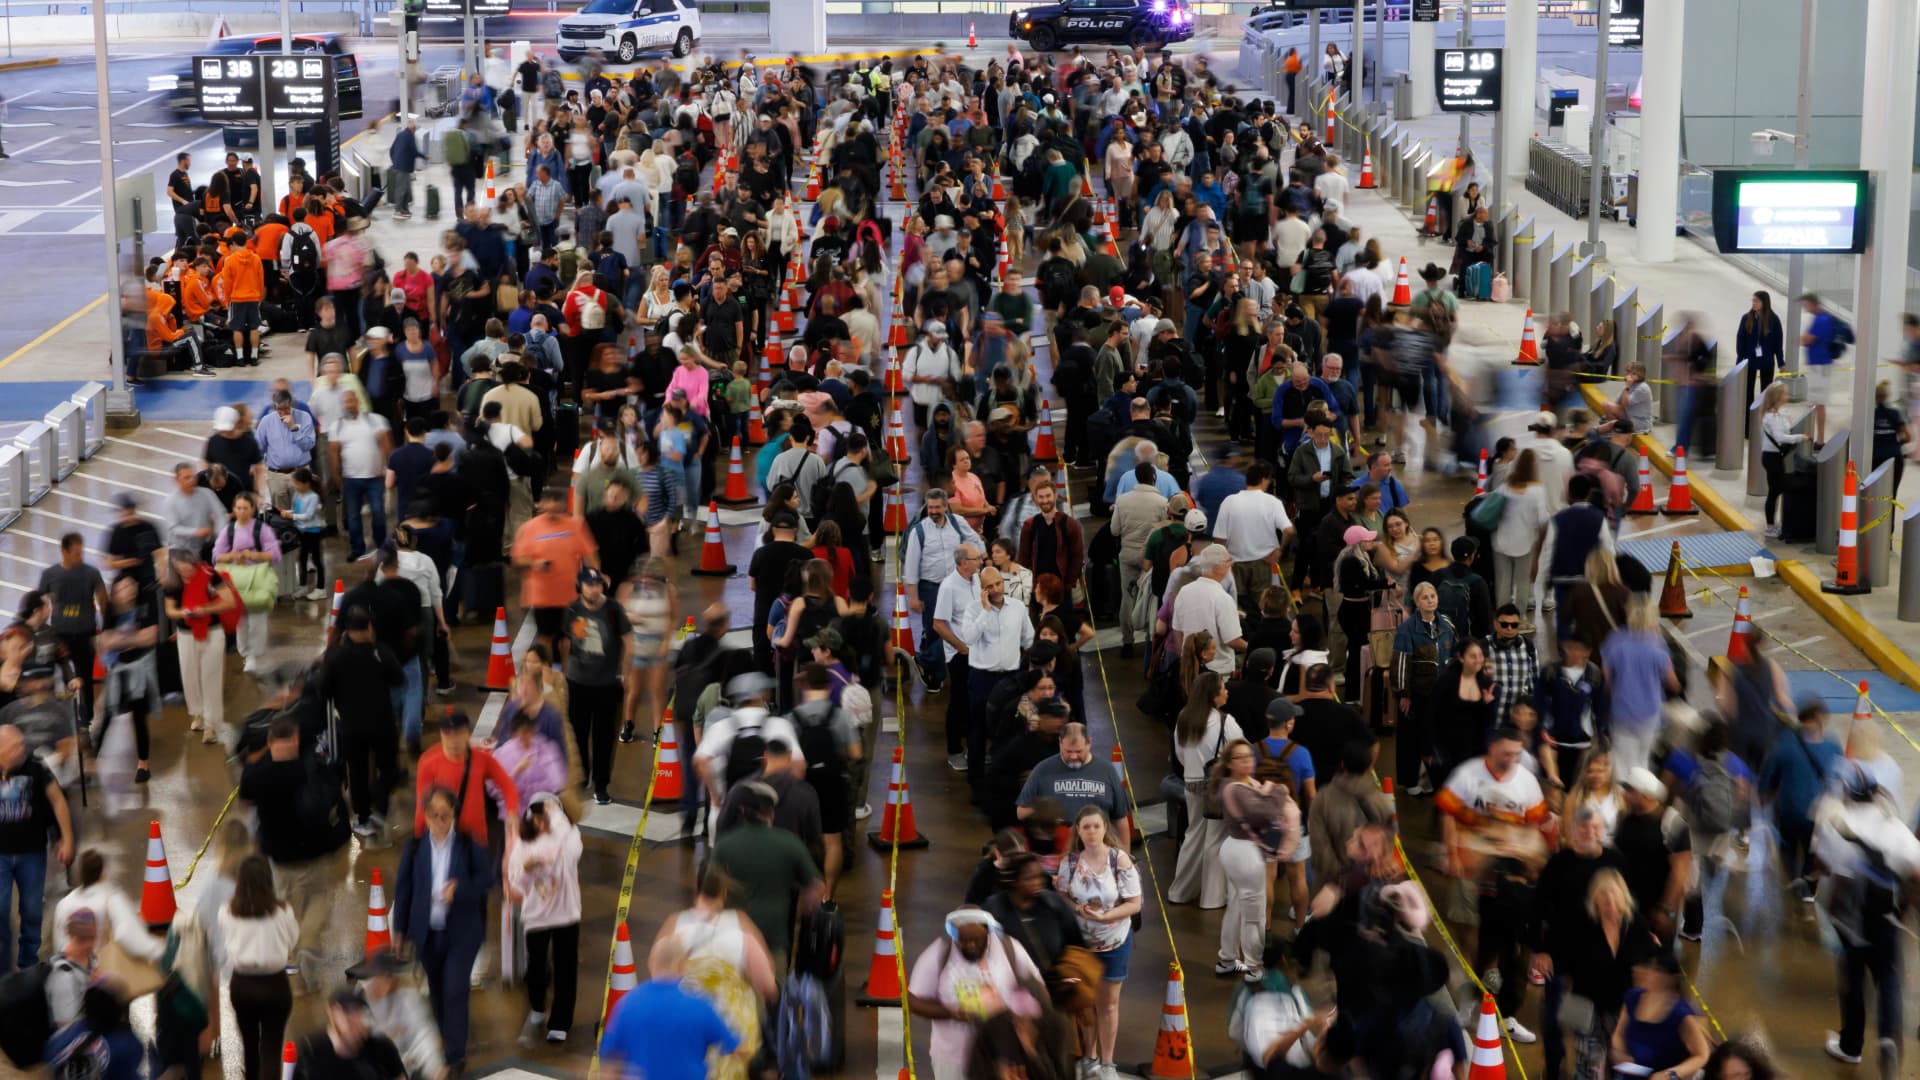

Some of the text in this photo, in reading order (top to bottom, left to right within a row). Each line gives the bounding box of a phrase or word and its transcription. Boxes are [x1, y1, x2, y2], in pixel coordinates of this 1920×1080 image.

[1067, 20, 1123, 28] POLICE
[226, 60, 253, 78] 3B
[271, 60, 298, 78] 2B
[1469, 53, 1495, 71] 1B
[1054, 780, 1106, 793] DADALORIAN
